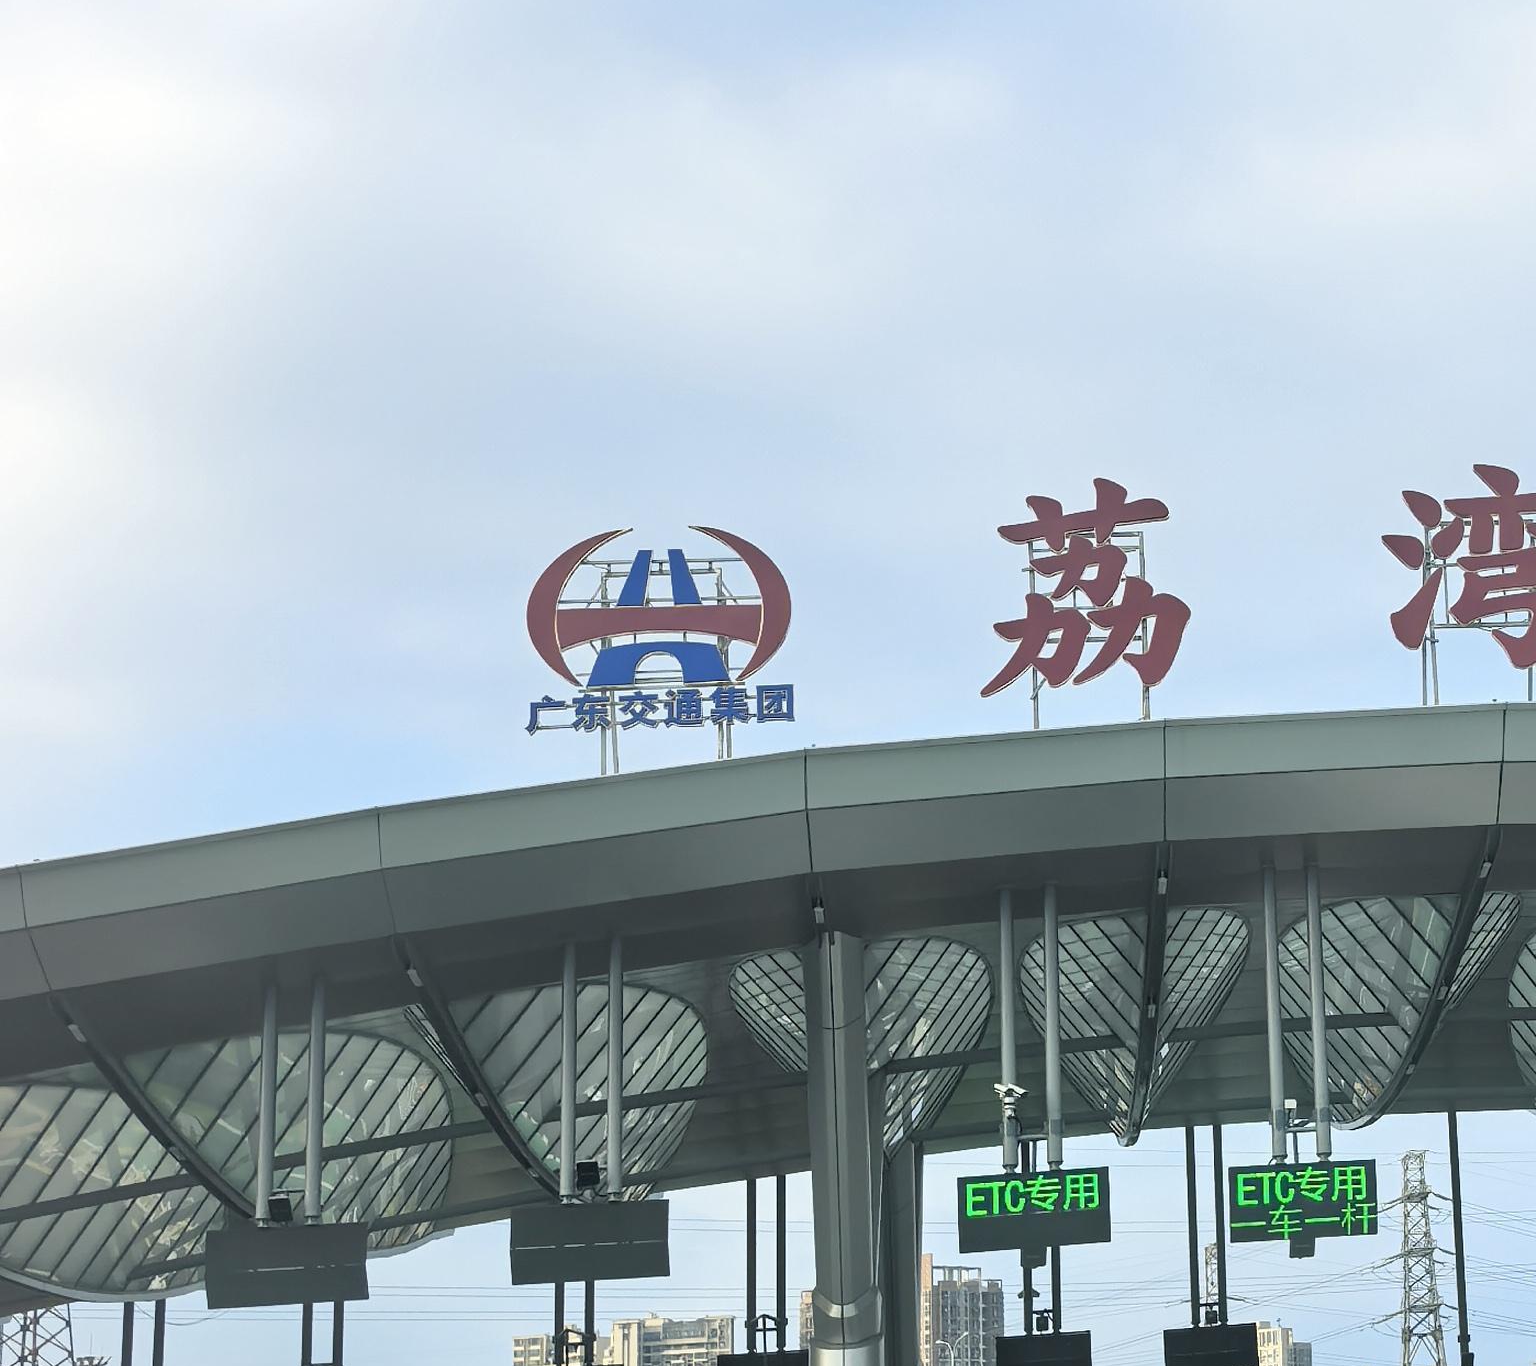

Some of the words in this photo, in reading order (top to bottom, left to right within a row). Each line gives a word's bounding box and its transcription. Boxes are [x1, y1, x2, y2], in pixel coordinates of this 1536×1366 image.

[525, 683, 796, 736] 广东交通集团
[965, 1173, 1100, 1218] ETC专用
[1236, 1166, 1367, 1206] ETC专用
[1230, 1202, 1377, 1239] 一车一杆
